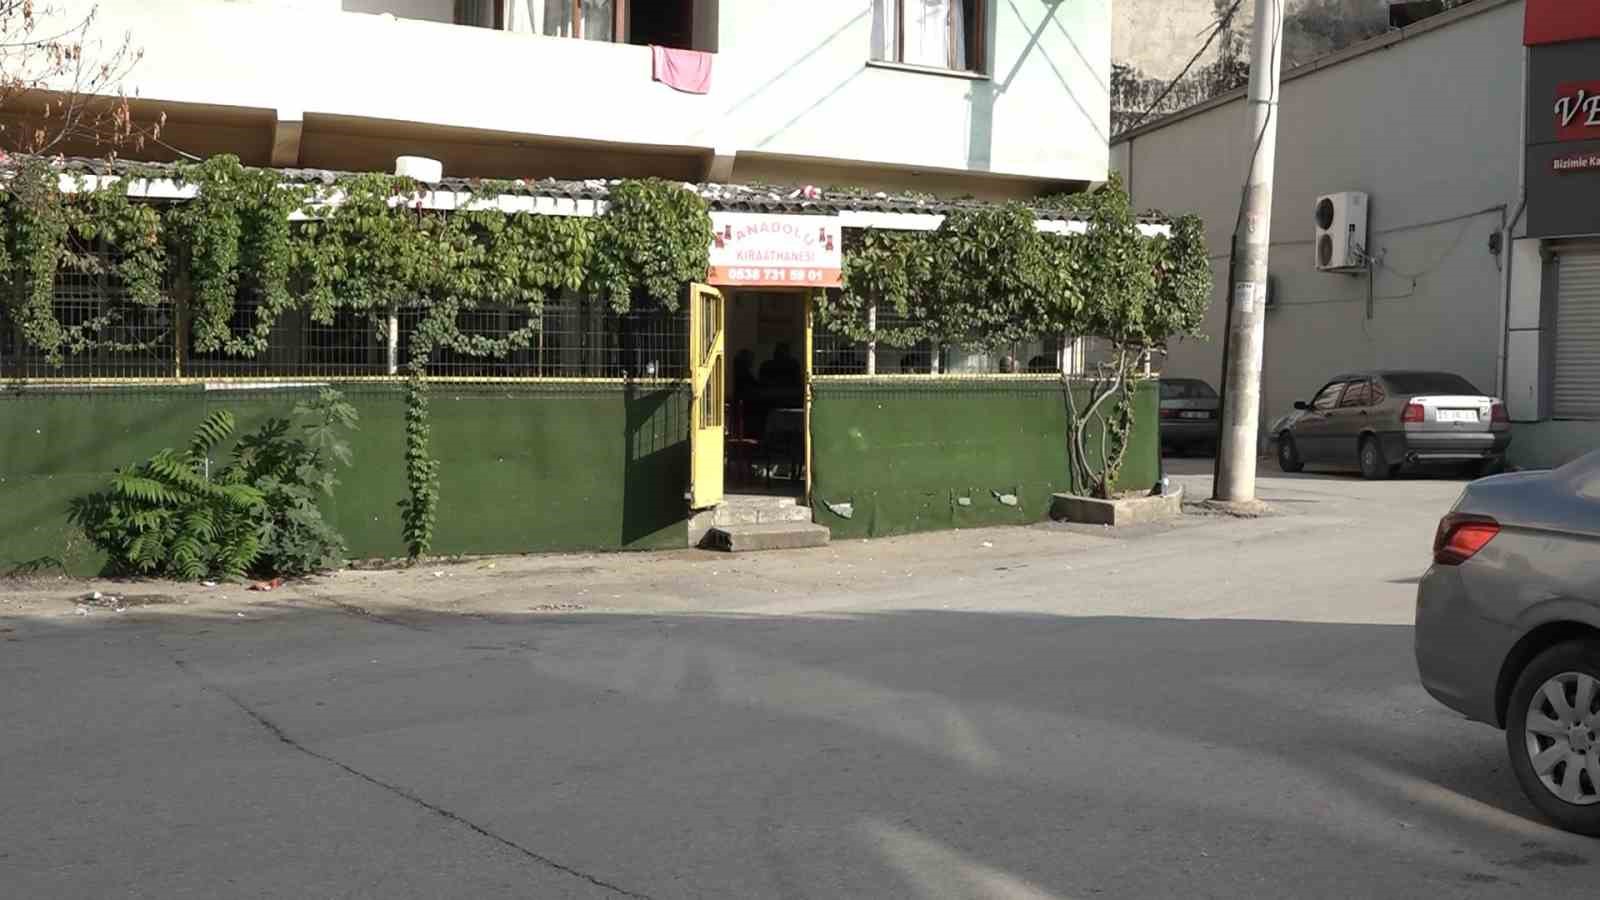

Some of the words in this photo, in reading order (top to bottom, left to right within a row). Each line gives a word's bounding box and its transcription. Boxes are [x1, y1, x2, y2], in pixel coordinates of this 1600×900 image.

[1553, 157, 1588, 169] Bizimle
[736, 222, 815, 246] ANADOLU
[764, 268, 785, 280] 731
[808, 269, 823, 281] 01
